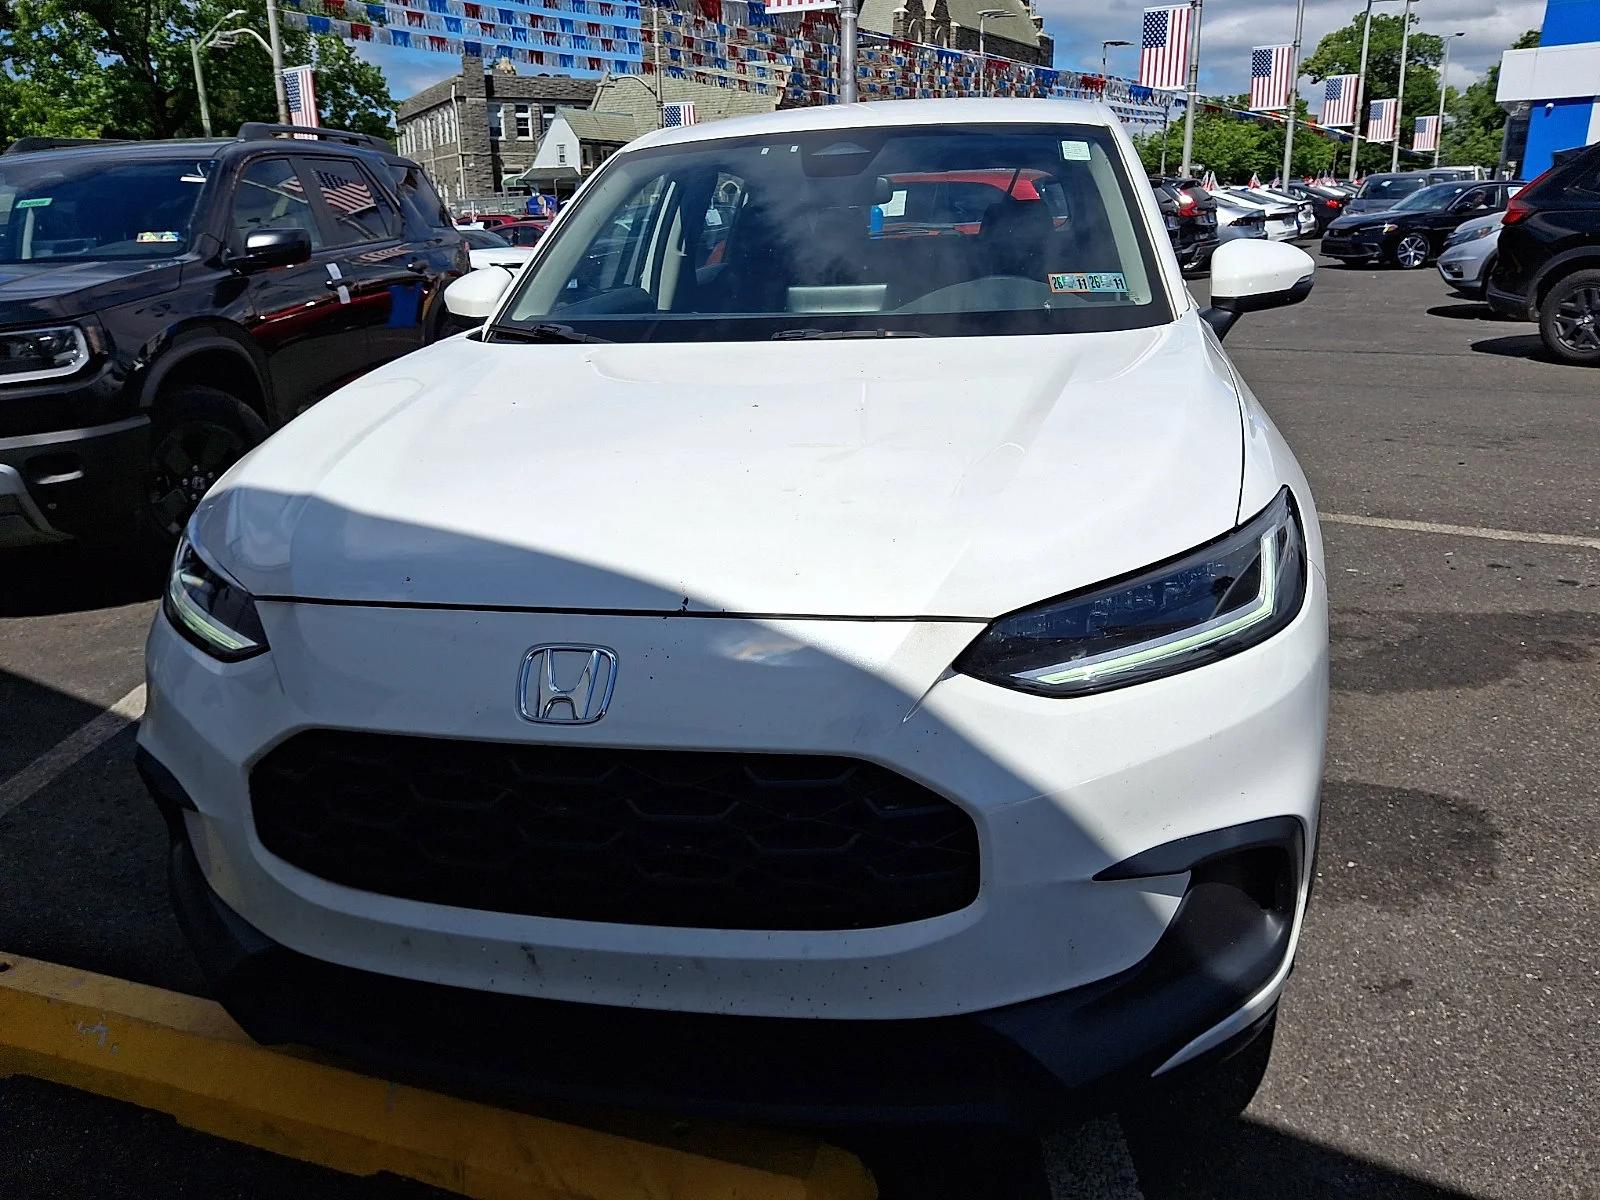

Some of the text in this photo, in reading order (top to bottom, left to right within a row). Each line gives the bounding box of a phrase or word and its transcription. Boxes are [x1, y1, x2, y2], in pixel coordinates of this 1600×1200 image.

[1052, 276, 1088, 289] 26 11
[1089, 276, 1125, 289] 26 11
